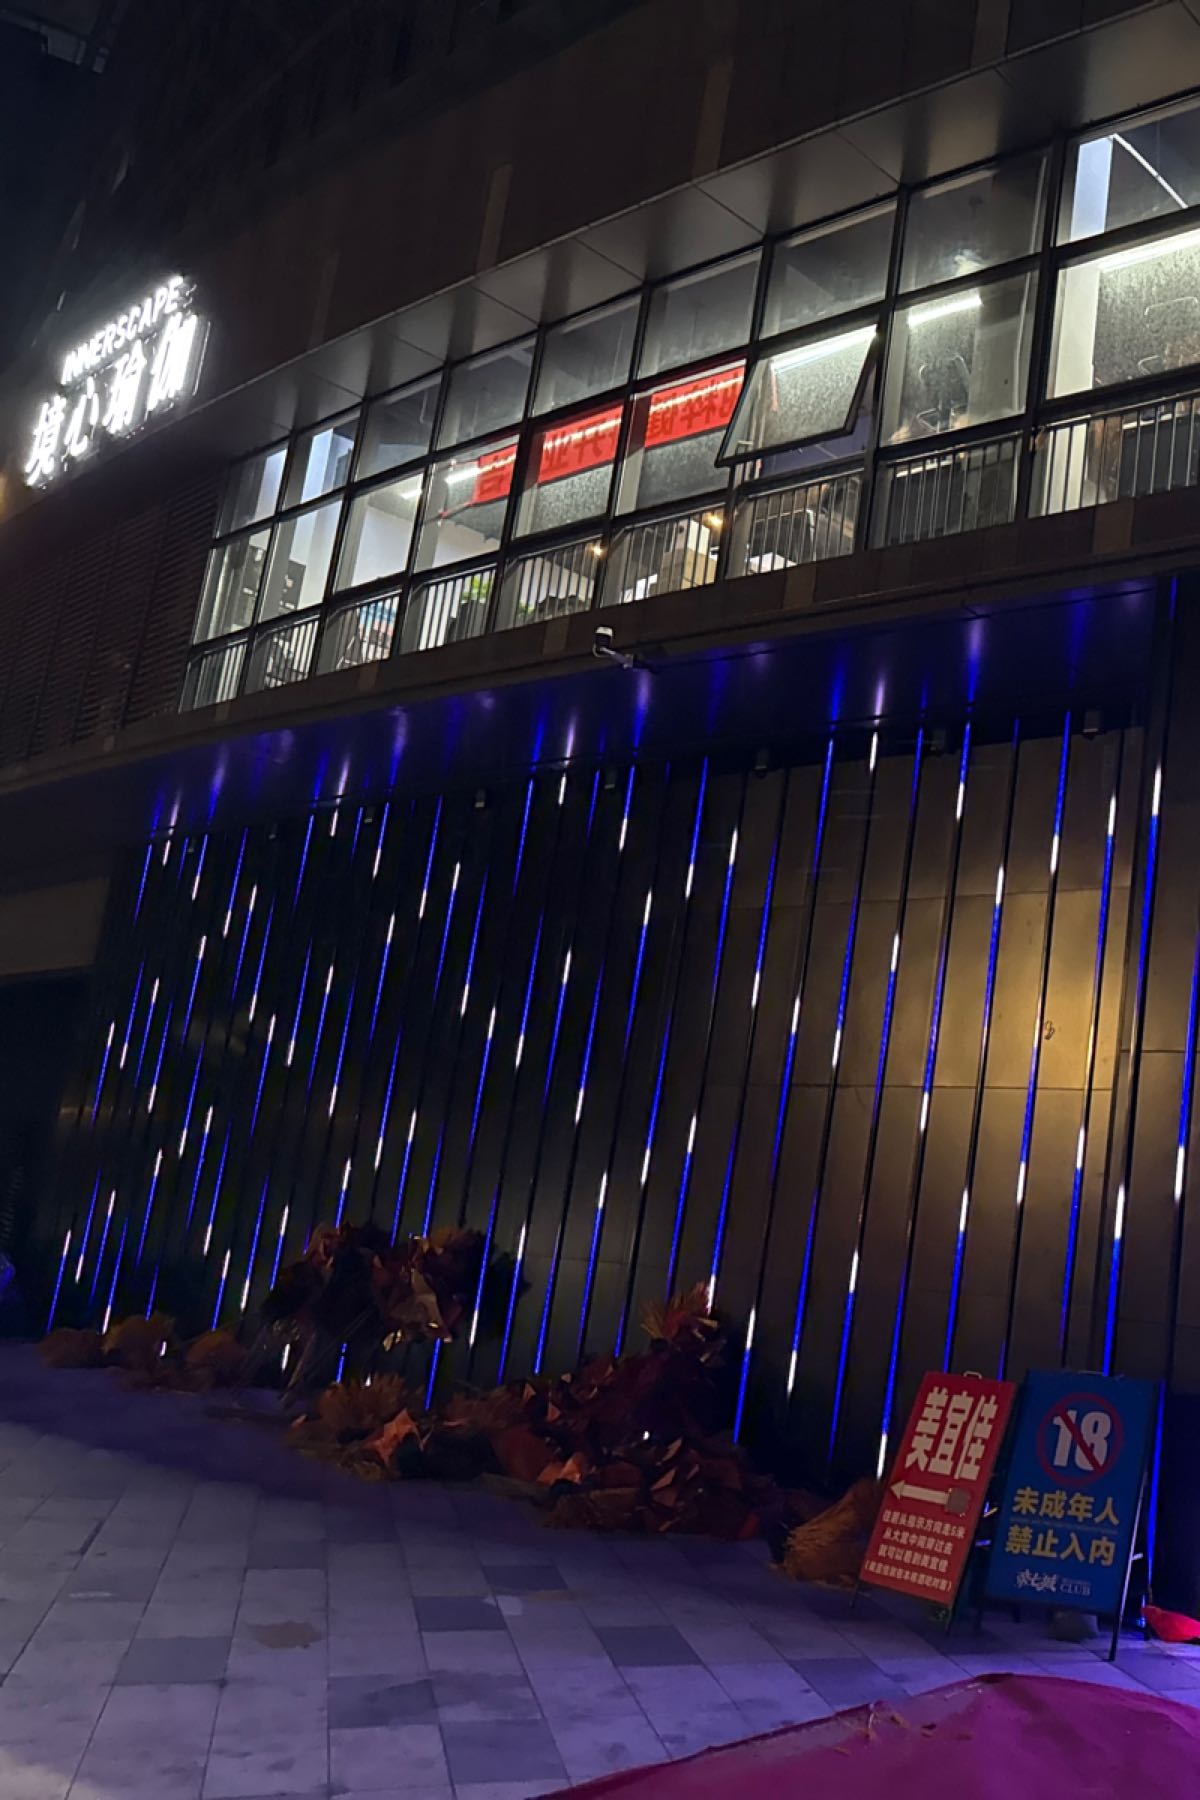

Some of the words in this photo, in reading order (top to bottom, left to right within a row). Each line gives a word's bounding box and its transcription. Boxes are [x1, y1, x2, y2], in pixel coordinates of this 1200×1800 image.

[904, 1386, 999, 1481] 美宜佳
[1052, 1408, 1112, 1471] 18
[1011, 1486, 1120, 1527] 未成年人
[1005, 1524, 1117, 1567] 禁止入内
[1059, 1583, 1091, 1597] CLUB
